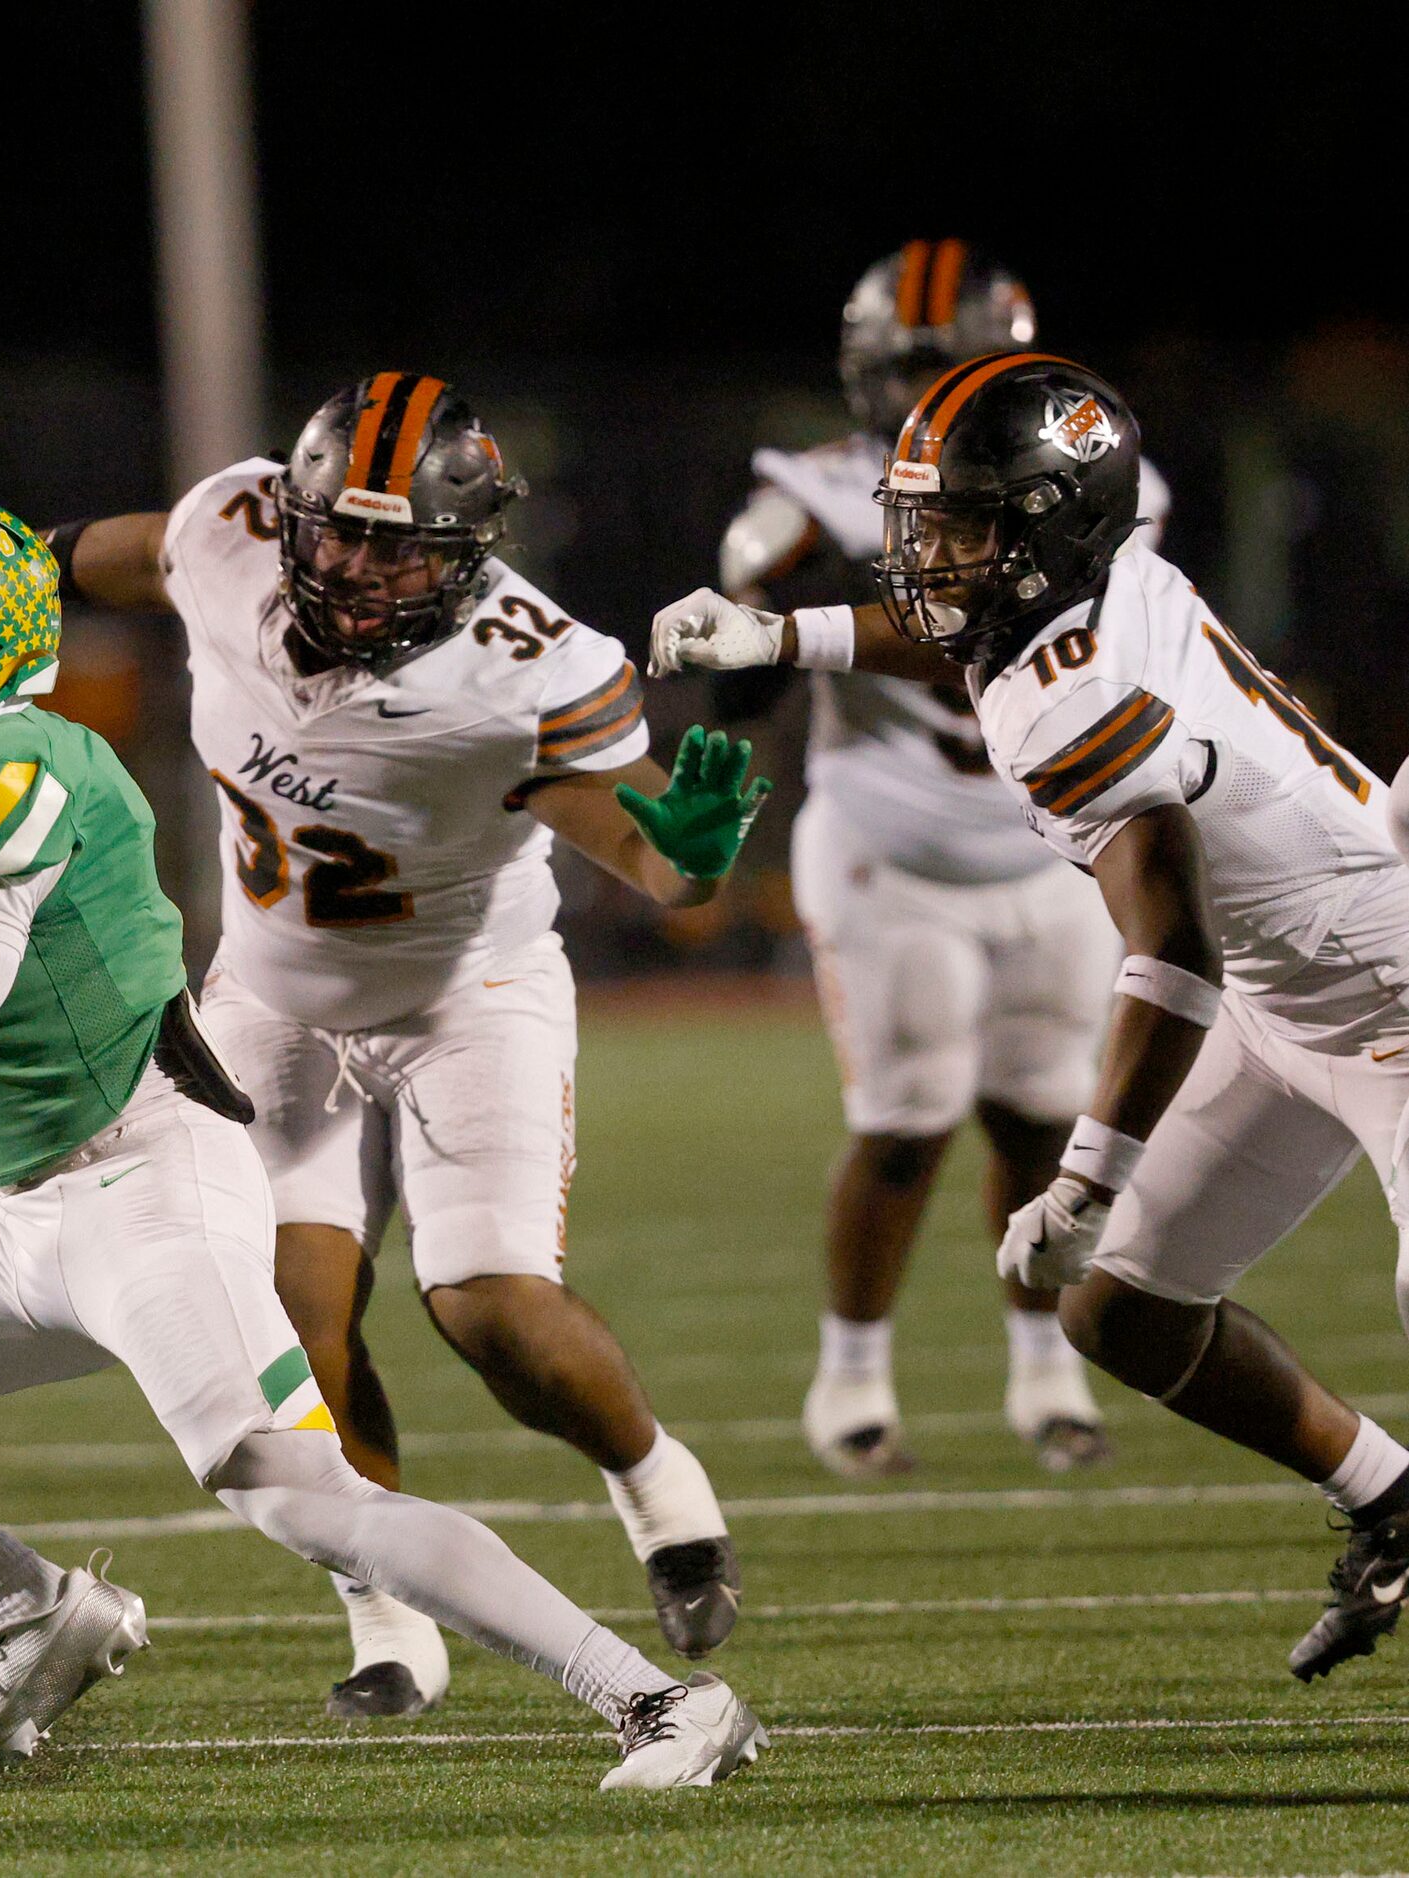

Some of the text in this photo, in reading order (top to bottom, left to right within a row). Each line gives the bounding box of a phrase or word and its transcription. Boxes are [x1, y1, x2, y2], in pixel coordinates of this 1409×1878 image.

[472, 595, 574, 662] 32
[1030, 627, 1099, 690] 10
[237, 732, 340, 812] West
